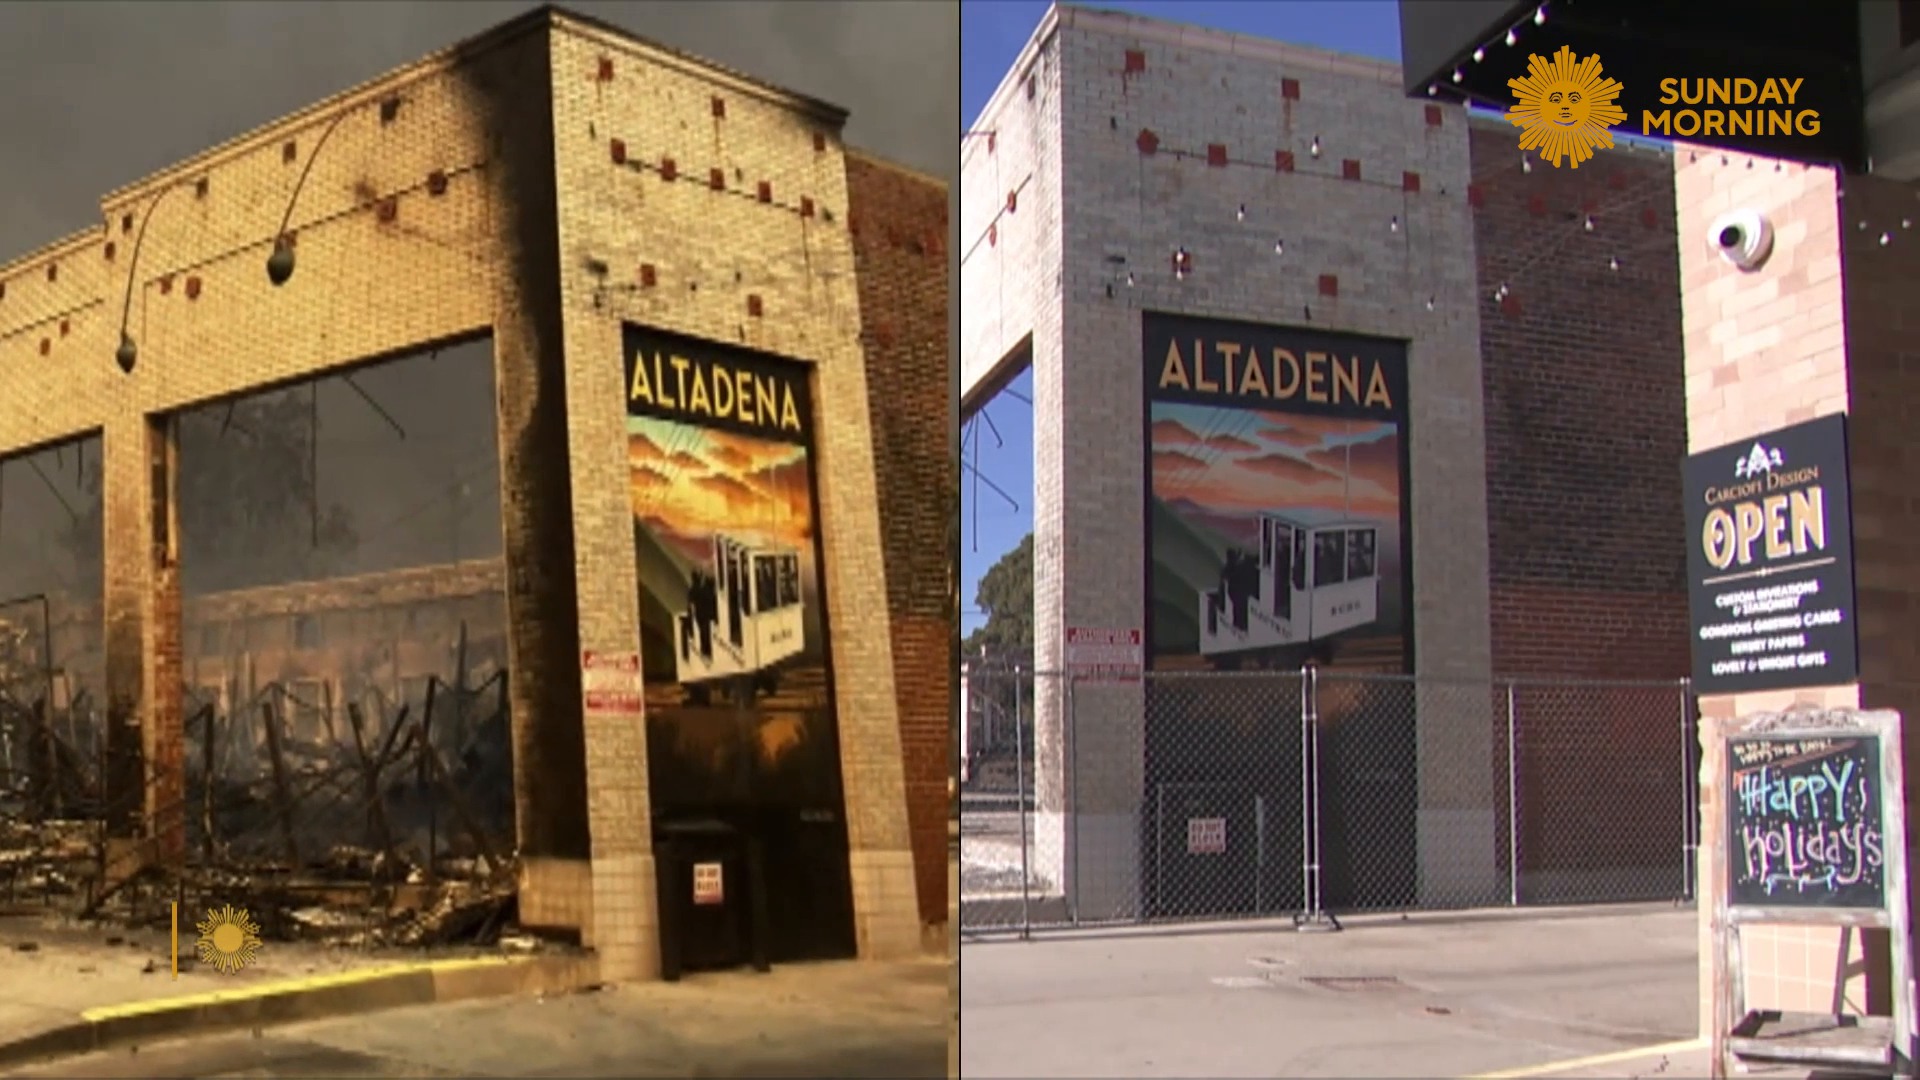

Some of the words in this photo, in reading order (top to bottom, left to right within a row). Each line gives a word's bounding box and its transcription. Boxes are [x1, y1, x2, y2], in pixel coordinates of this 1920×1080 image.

[631, 351, 800, 432] ALTADENA
[1159, 336, 1391, 410] ALTADENA
[1702, 484, 1825, 570] OPEN
[1767, 633, 1805, 650] PAPERS
[1803, 609, 1841, 628] CARDS
[1711, 660, 1746, 675] LOVELY
[1797, 651, 1826, 668] GIFTS
